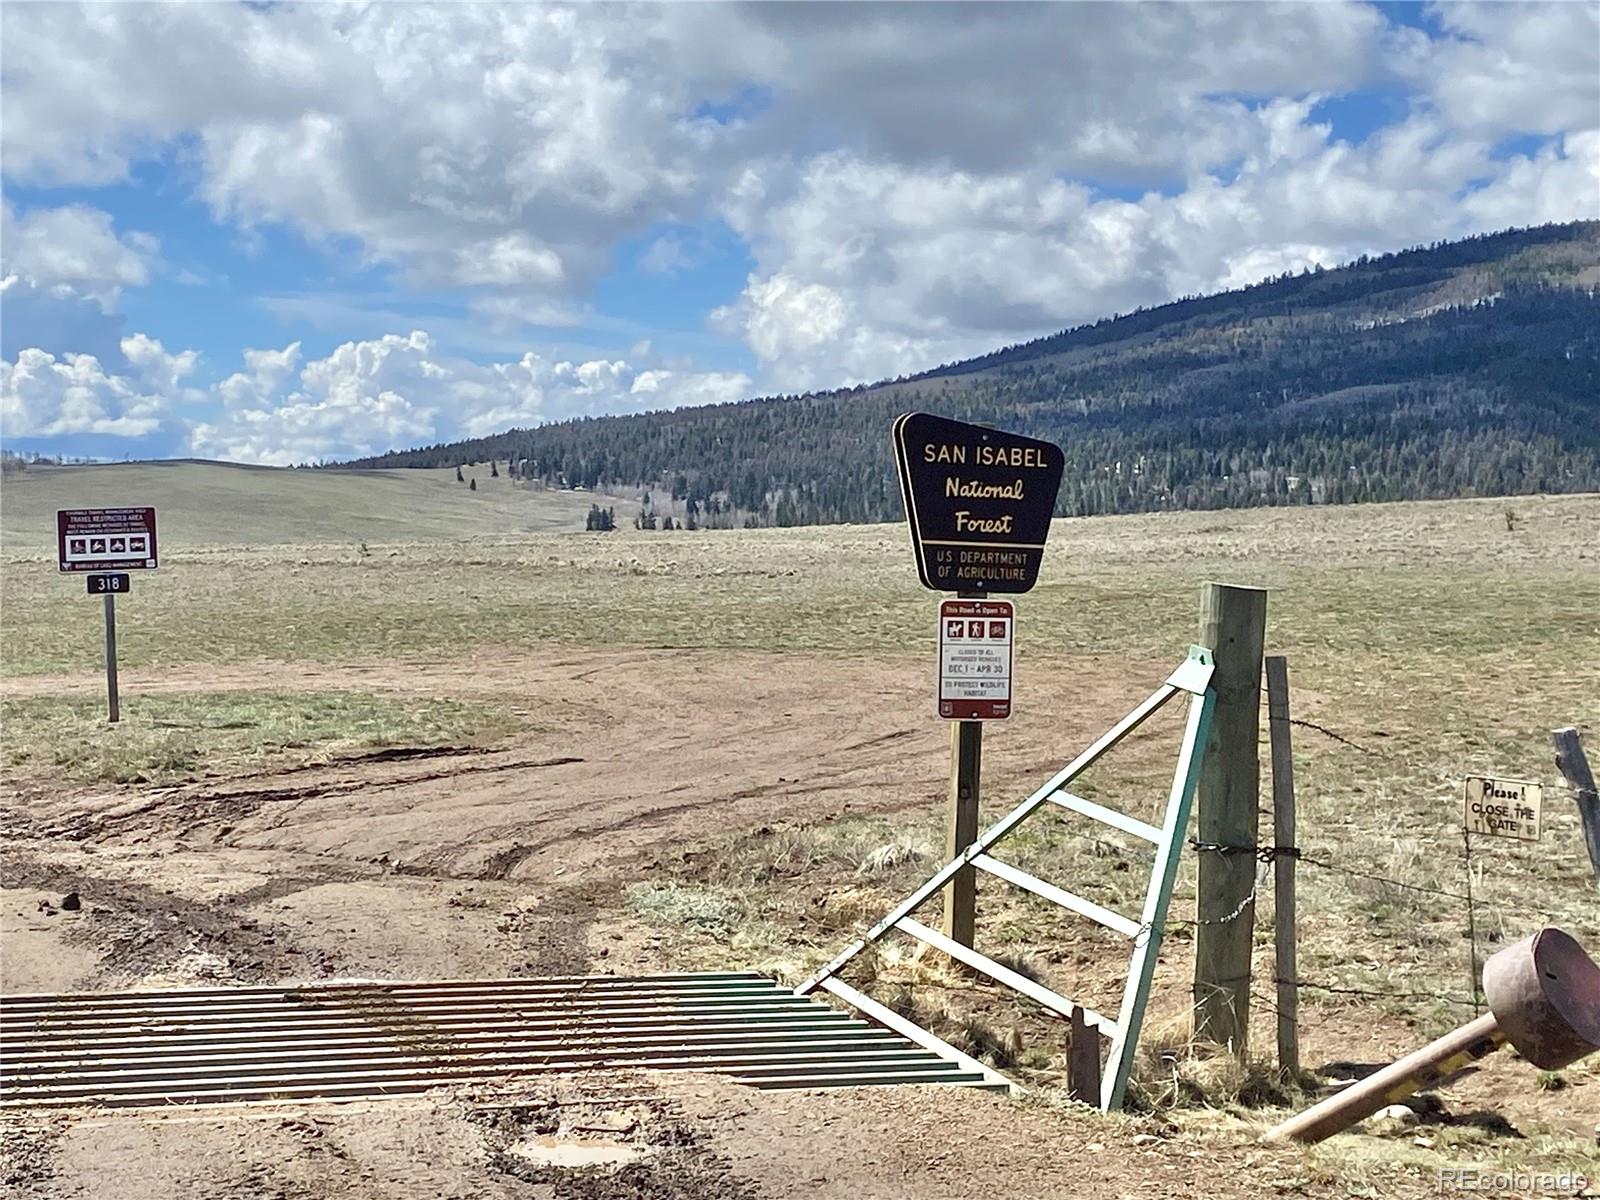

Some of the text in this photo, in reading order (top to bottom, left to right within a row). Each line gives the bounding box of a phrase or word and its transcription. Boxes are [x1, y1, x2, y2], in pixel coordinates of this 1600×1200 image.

[924, 444, 1048, 468] SAN ISABEL
[945, 477, 1024, 500] National
[955, 511, 1013, 533] Forest
[937, 551, 1028, 565] US DEPARTMENT
[938, 566, 1026, 581] OF AGRICULTURE
[98, 577, 120, 591] 318
[949, 665, 963, 673] DEC
[976, 665, 991, 673] APR
[993, 665, 1003, 673] 30
[1472, 803, 1535, 820] CLOSE THE
[1490, 819, 1516, 831] GATE
